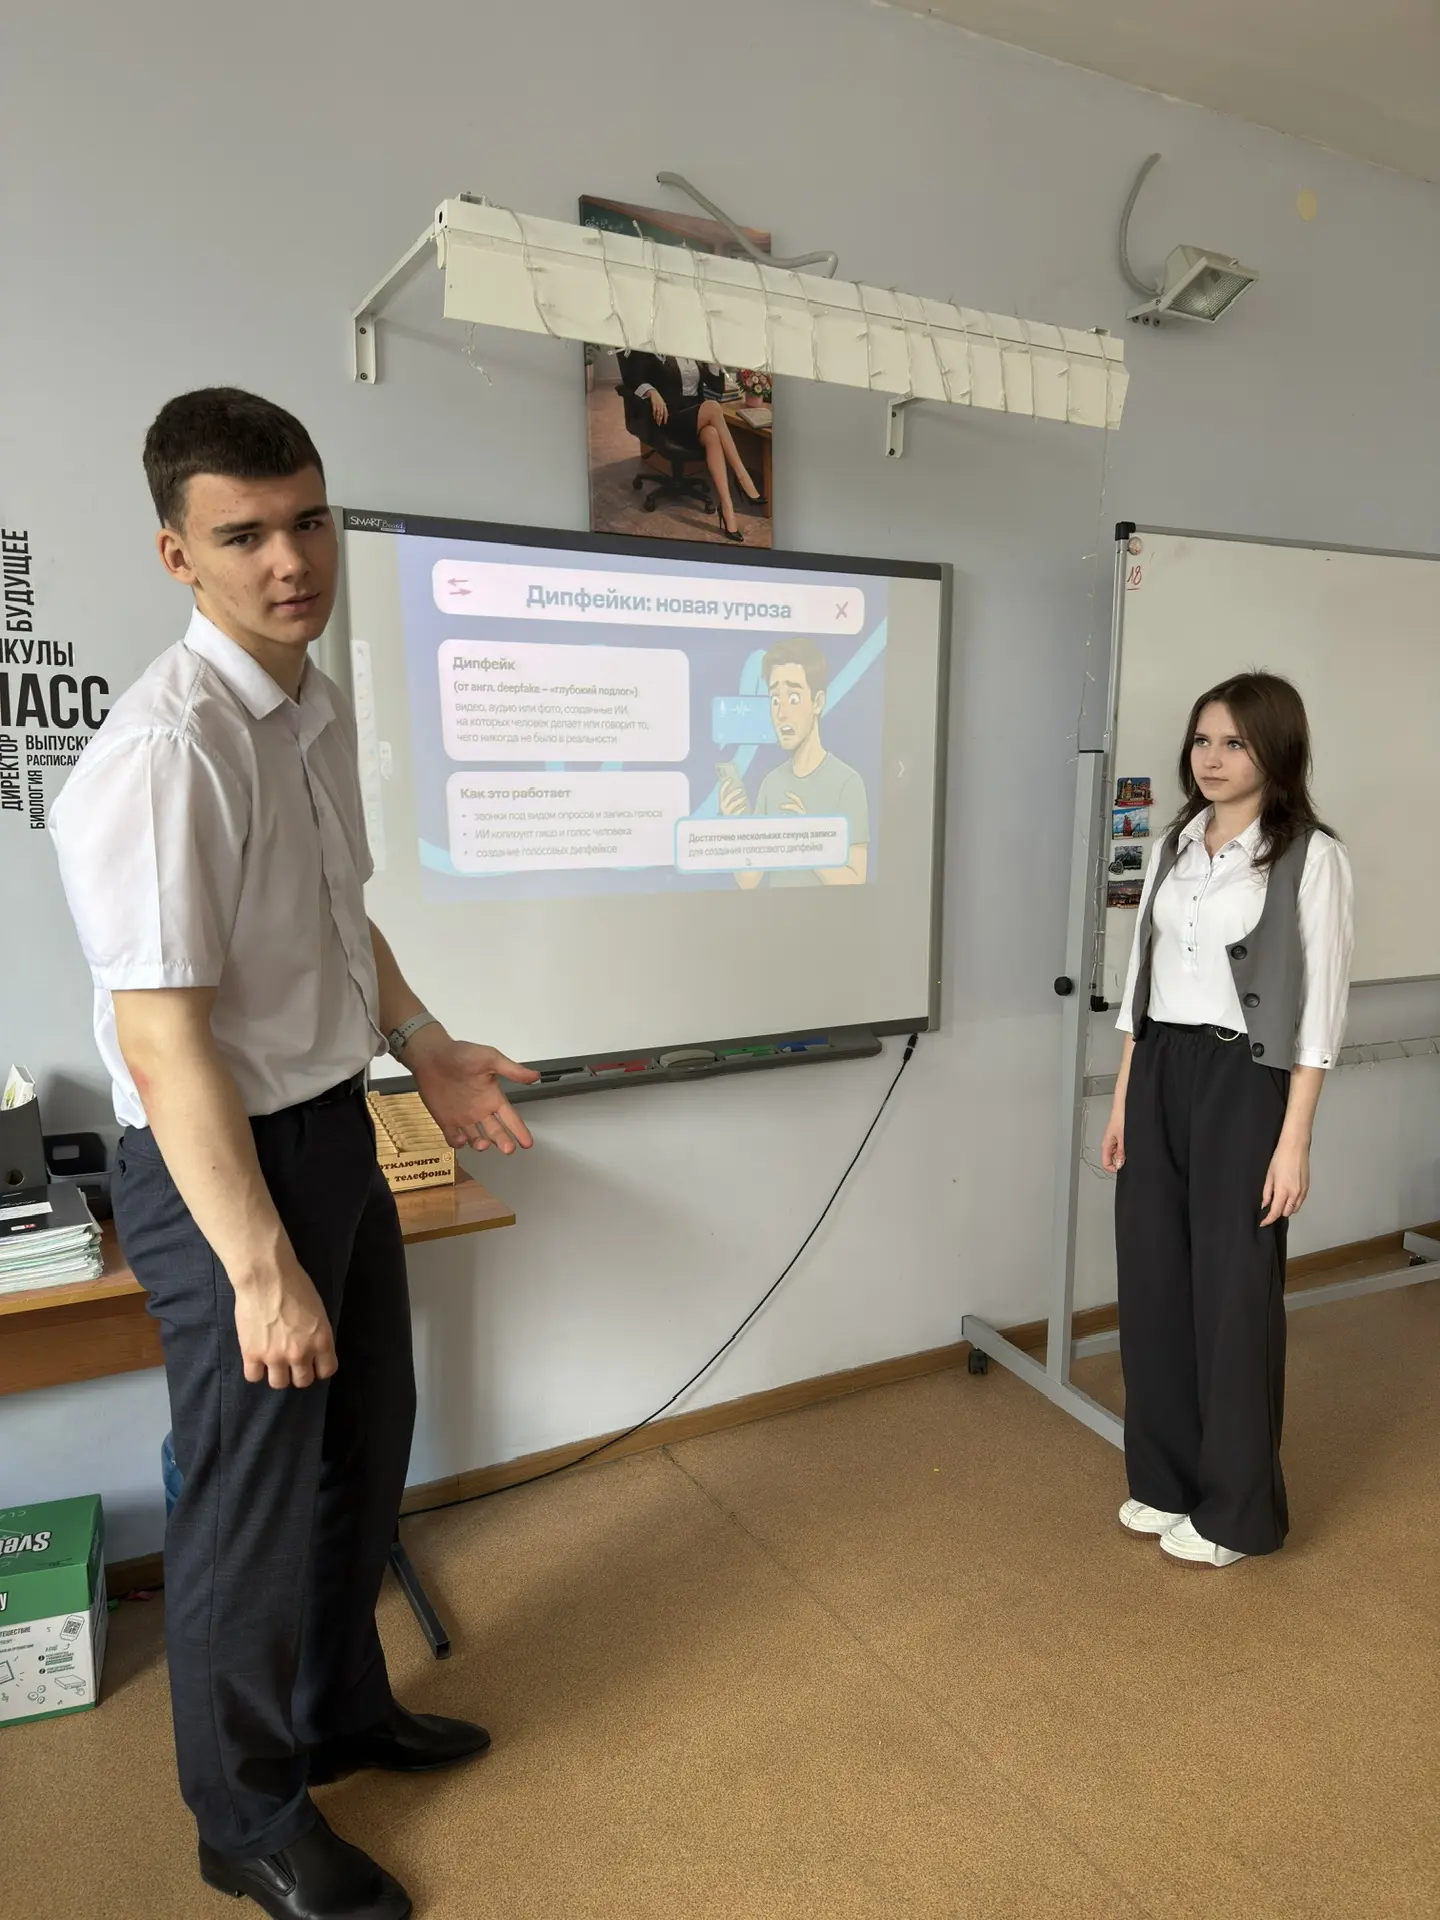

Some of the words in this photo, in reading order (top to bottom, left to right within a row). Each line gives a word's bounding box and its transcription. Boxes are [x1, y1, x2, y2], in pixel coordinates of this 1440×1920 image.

[350, 515, 382, 527] SMART
[1, 529, 35, 632] БУДУЩЕЕ
[526, 584, 652, 613] Дипфейки:
[656, 596, 719, 615] новая
[722, 599, 792, 621] угроза
[452, 656, 516, 672] Дипфейк
[453, 681, 469, 693] (от
[471, 683, 496, 693] англ.
[497, 683, 540, 696] deepfake
[489, 704, 517, 714] аудио
[518, 705, 536, 713] или
[564, 706, 613, 715] созданные
[456, 718, 469, 727] на
[470, 718, 510, 728] которых
[512, 719, 549, 728] человек
[550, 720, 582, 730] делает
[583, 721, 600, 729] или
[601, 721, 636, 731] говорит
[457, 734, 479, 743] чего
[480, 734, 519, 744] никогда
[520, 735, 532, 743] не
[533, 733, 557, 743] было
[566, 735, 617, 745] реальности
[0, 733, 23, 812] ДИРЕКТОР
[27, 769, 46, 829] БИОЛОГИЯ
[460, 788, 485, 799] Как
[487, 789, 510, 799] это
[512, 787, 572, 801] работает
[474, 812, 507, 822] звонки
[508, 811, 526, 822] под
[528, 811, 556, 821] видом
[557, 810, 595, 822] опросов
[634, 809, 663, 819] голоса
[491, 829, 534, 841] копирует
[535, 829, 558, 839] лицо
[566, 828, 591, 838] голос
[592, 827, 632, 837] человека
[688, 832, 736, 844] Достаточно
[737, 832, 782, 842] нескольких
[782, 831, 809, 841] секунд
[810, 830, 837, 838] записи
[476, 848, 520, 858] создание
[521, 846, 568, 857] голосовых
[569, 844, 618, 856] дипфейков
[704, 846, 742, 856] создания
[743, 844, 786, 855] голосового
[394, 1169, 451, 1182] телефоны
